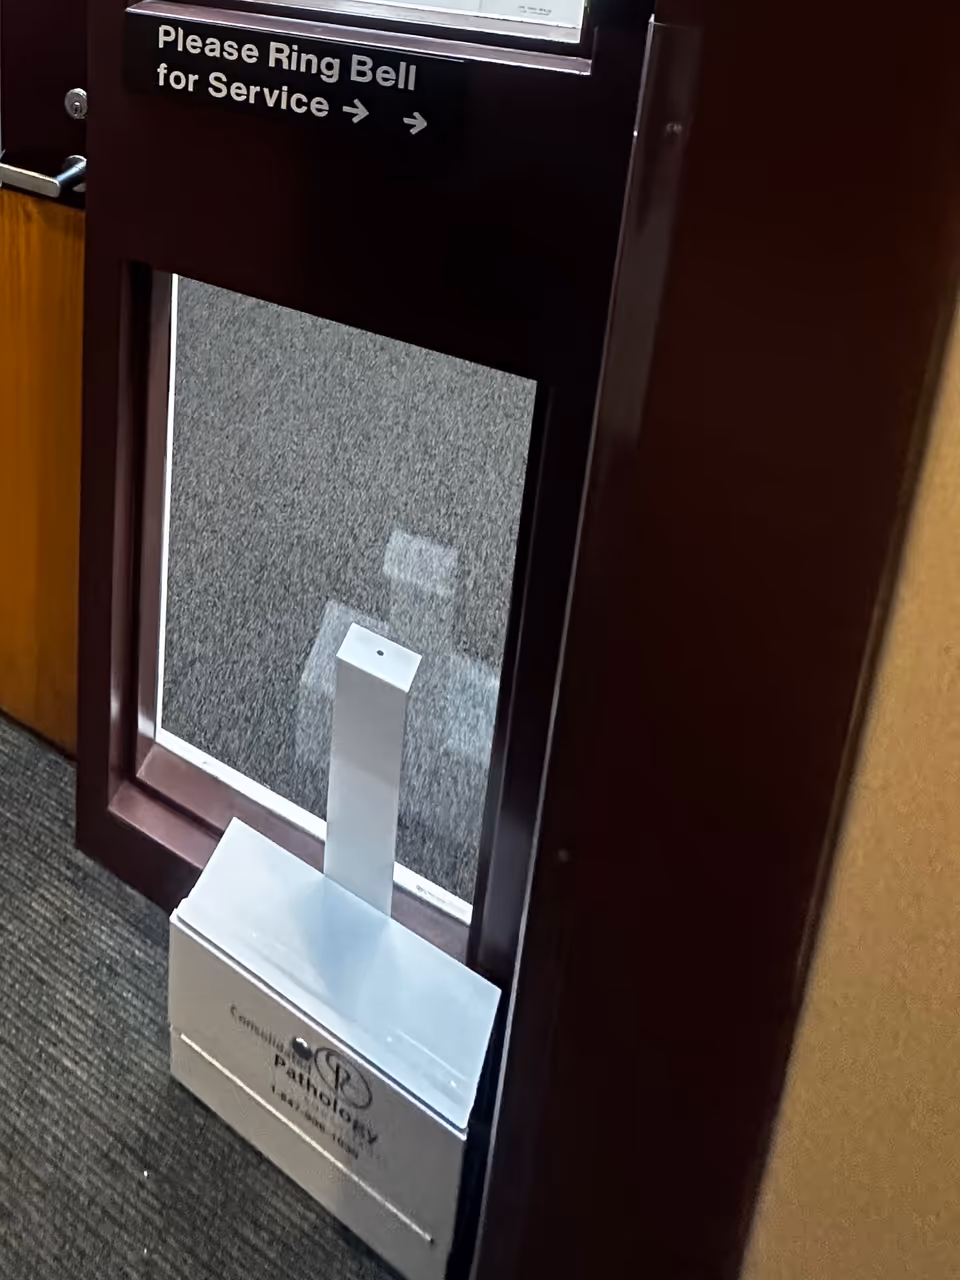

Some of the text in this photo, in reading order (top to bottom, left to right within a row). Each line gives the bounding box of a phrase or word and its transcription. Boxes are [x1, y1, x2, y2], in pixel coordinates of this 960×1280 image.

[157, 63, 330, 118] for Service
[158, 24, 417, 91] Please Ring Bell
[274, 1053, 379, 1146] Pathology
